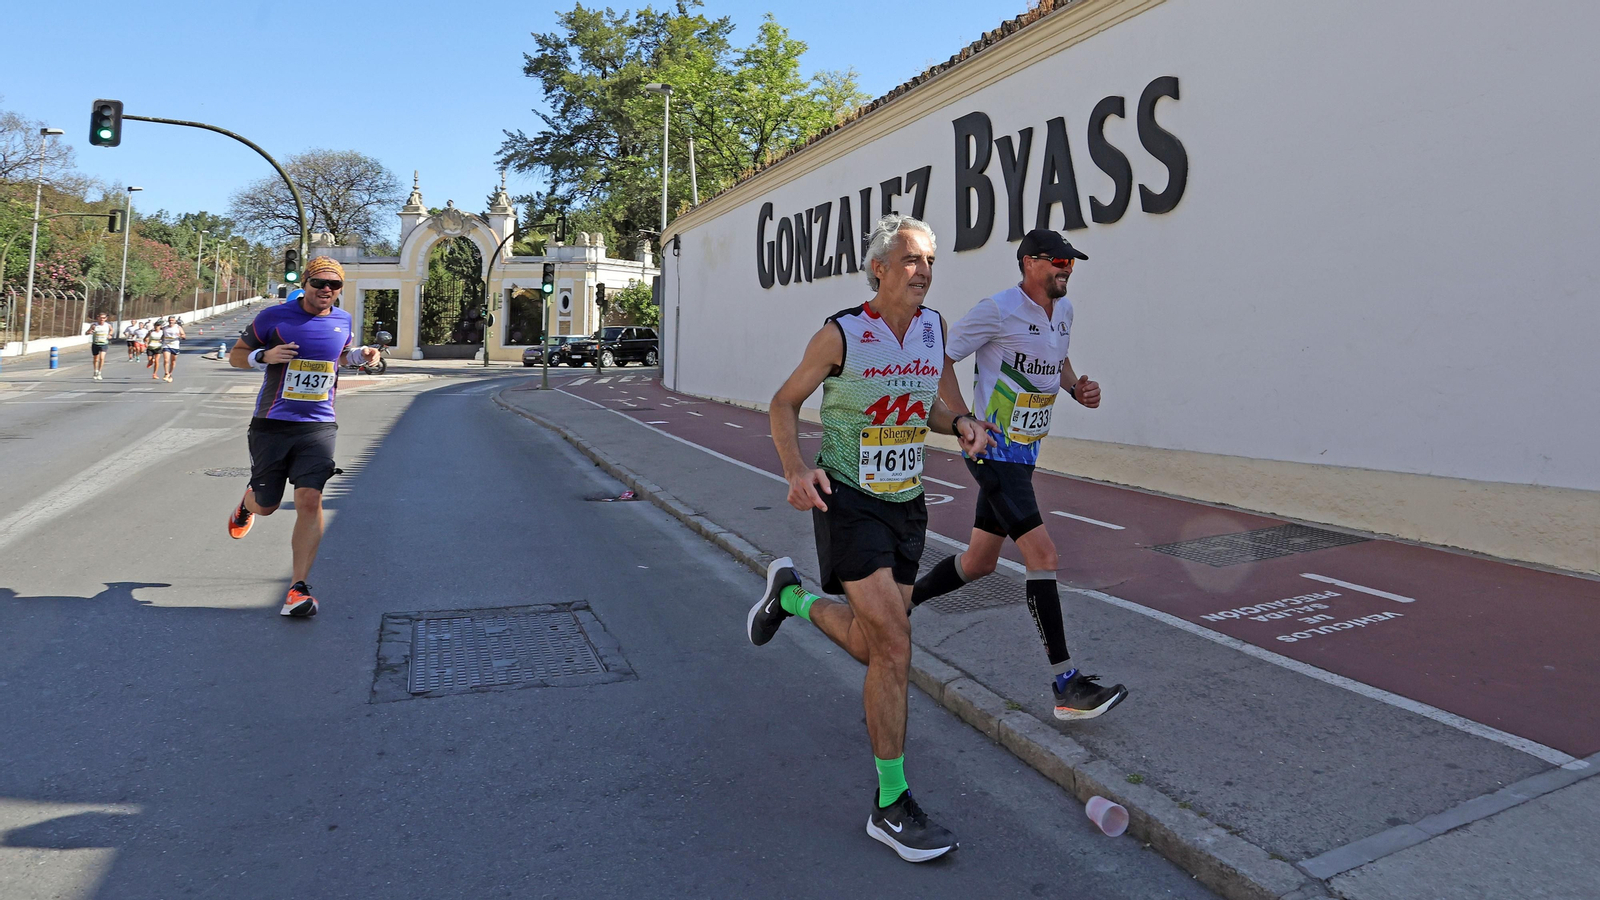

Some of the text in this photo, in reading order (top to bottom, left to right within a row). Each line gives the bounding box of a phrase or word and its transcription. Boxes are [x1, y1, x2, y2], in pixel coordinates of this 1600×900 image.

[953, 75, 1189, 252] BYASS
[302, 361, 326, 371] Sherry
[862, 358, 939, 378] maratón
[1013, 351, 1056, 375] Rabita
[294, 373, 329, 389] 1437
[886, 380, 922, 388] JEREZ
[1021, 409, 1050, 429] 1233
[883, 427, 913, 441] Sherry
[873, 447, 916, 472] 1619
[1200, 590, 1342, 622] PRECAUCIÓN
[1248, 603, 1330, 623] SALIDA
[1275, 611, 1405, 643] VEHÍCULOS
[1297, 613, 1335, 625] DE
